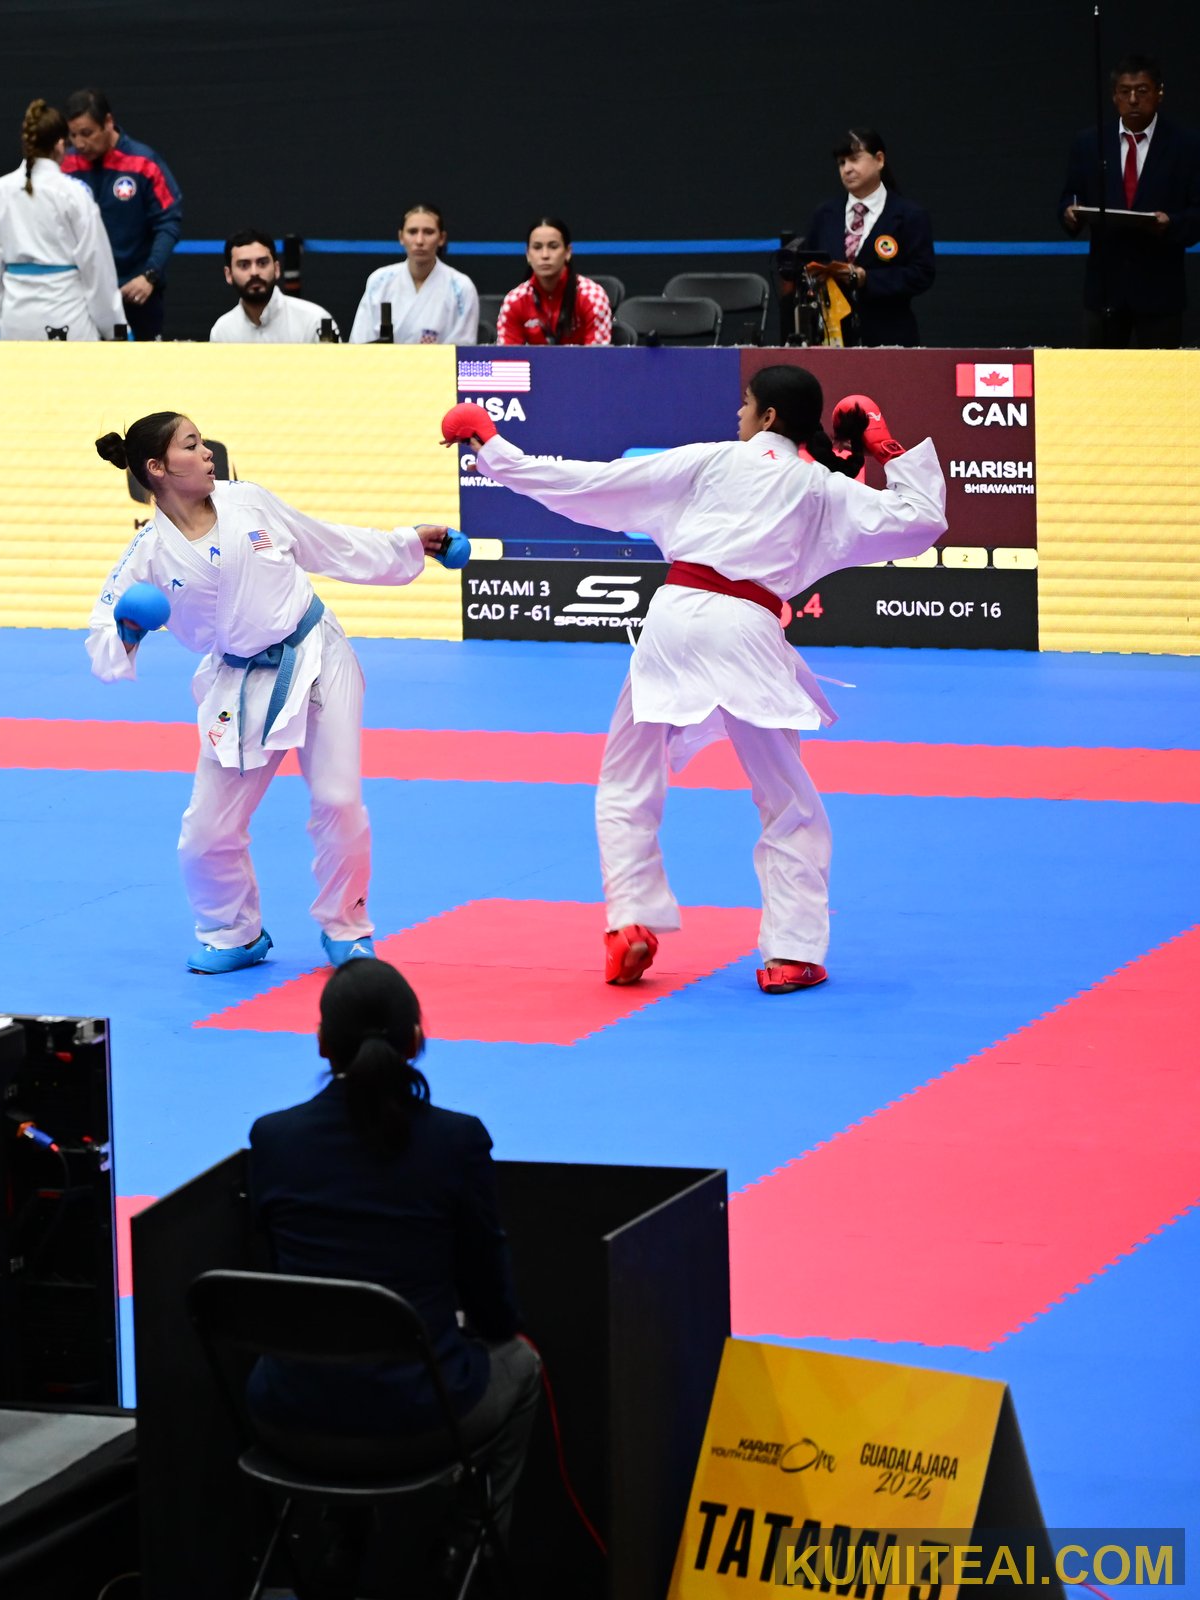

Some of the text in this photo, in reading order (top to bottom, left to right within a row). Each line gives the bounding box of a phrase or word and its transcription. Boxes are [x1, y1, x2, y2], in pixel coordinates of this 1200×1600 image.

[464, 397, 526, 422] SA
[962, 402, 1027, 427] CAN
[950, 460, 1033, 478] HARISH
[964, 483, 1035, 494] SHRAVANTHI
[468, 579, 550, 597] TATAMI 3
[467, 603, 550, 621] CAD F -61
[876, 600, 1002, 618] ROUND OF 16
[860, 1442, 958, 1481] GUADALAJARA
[874, 1470, 934, 1501] 2026
[694, 1500, 898, 1600] TATAMI
